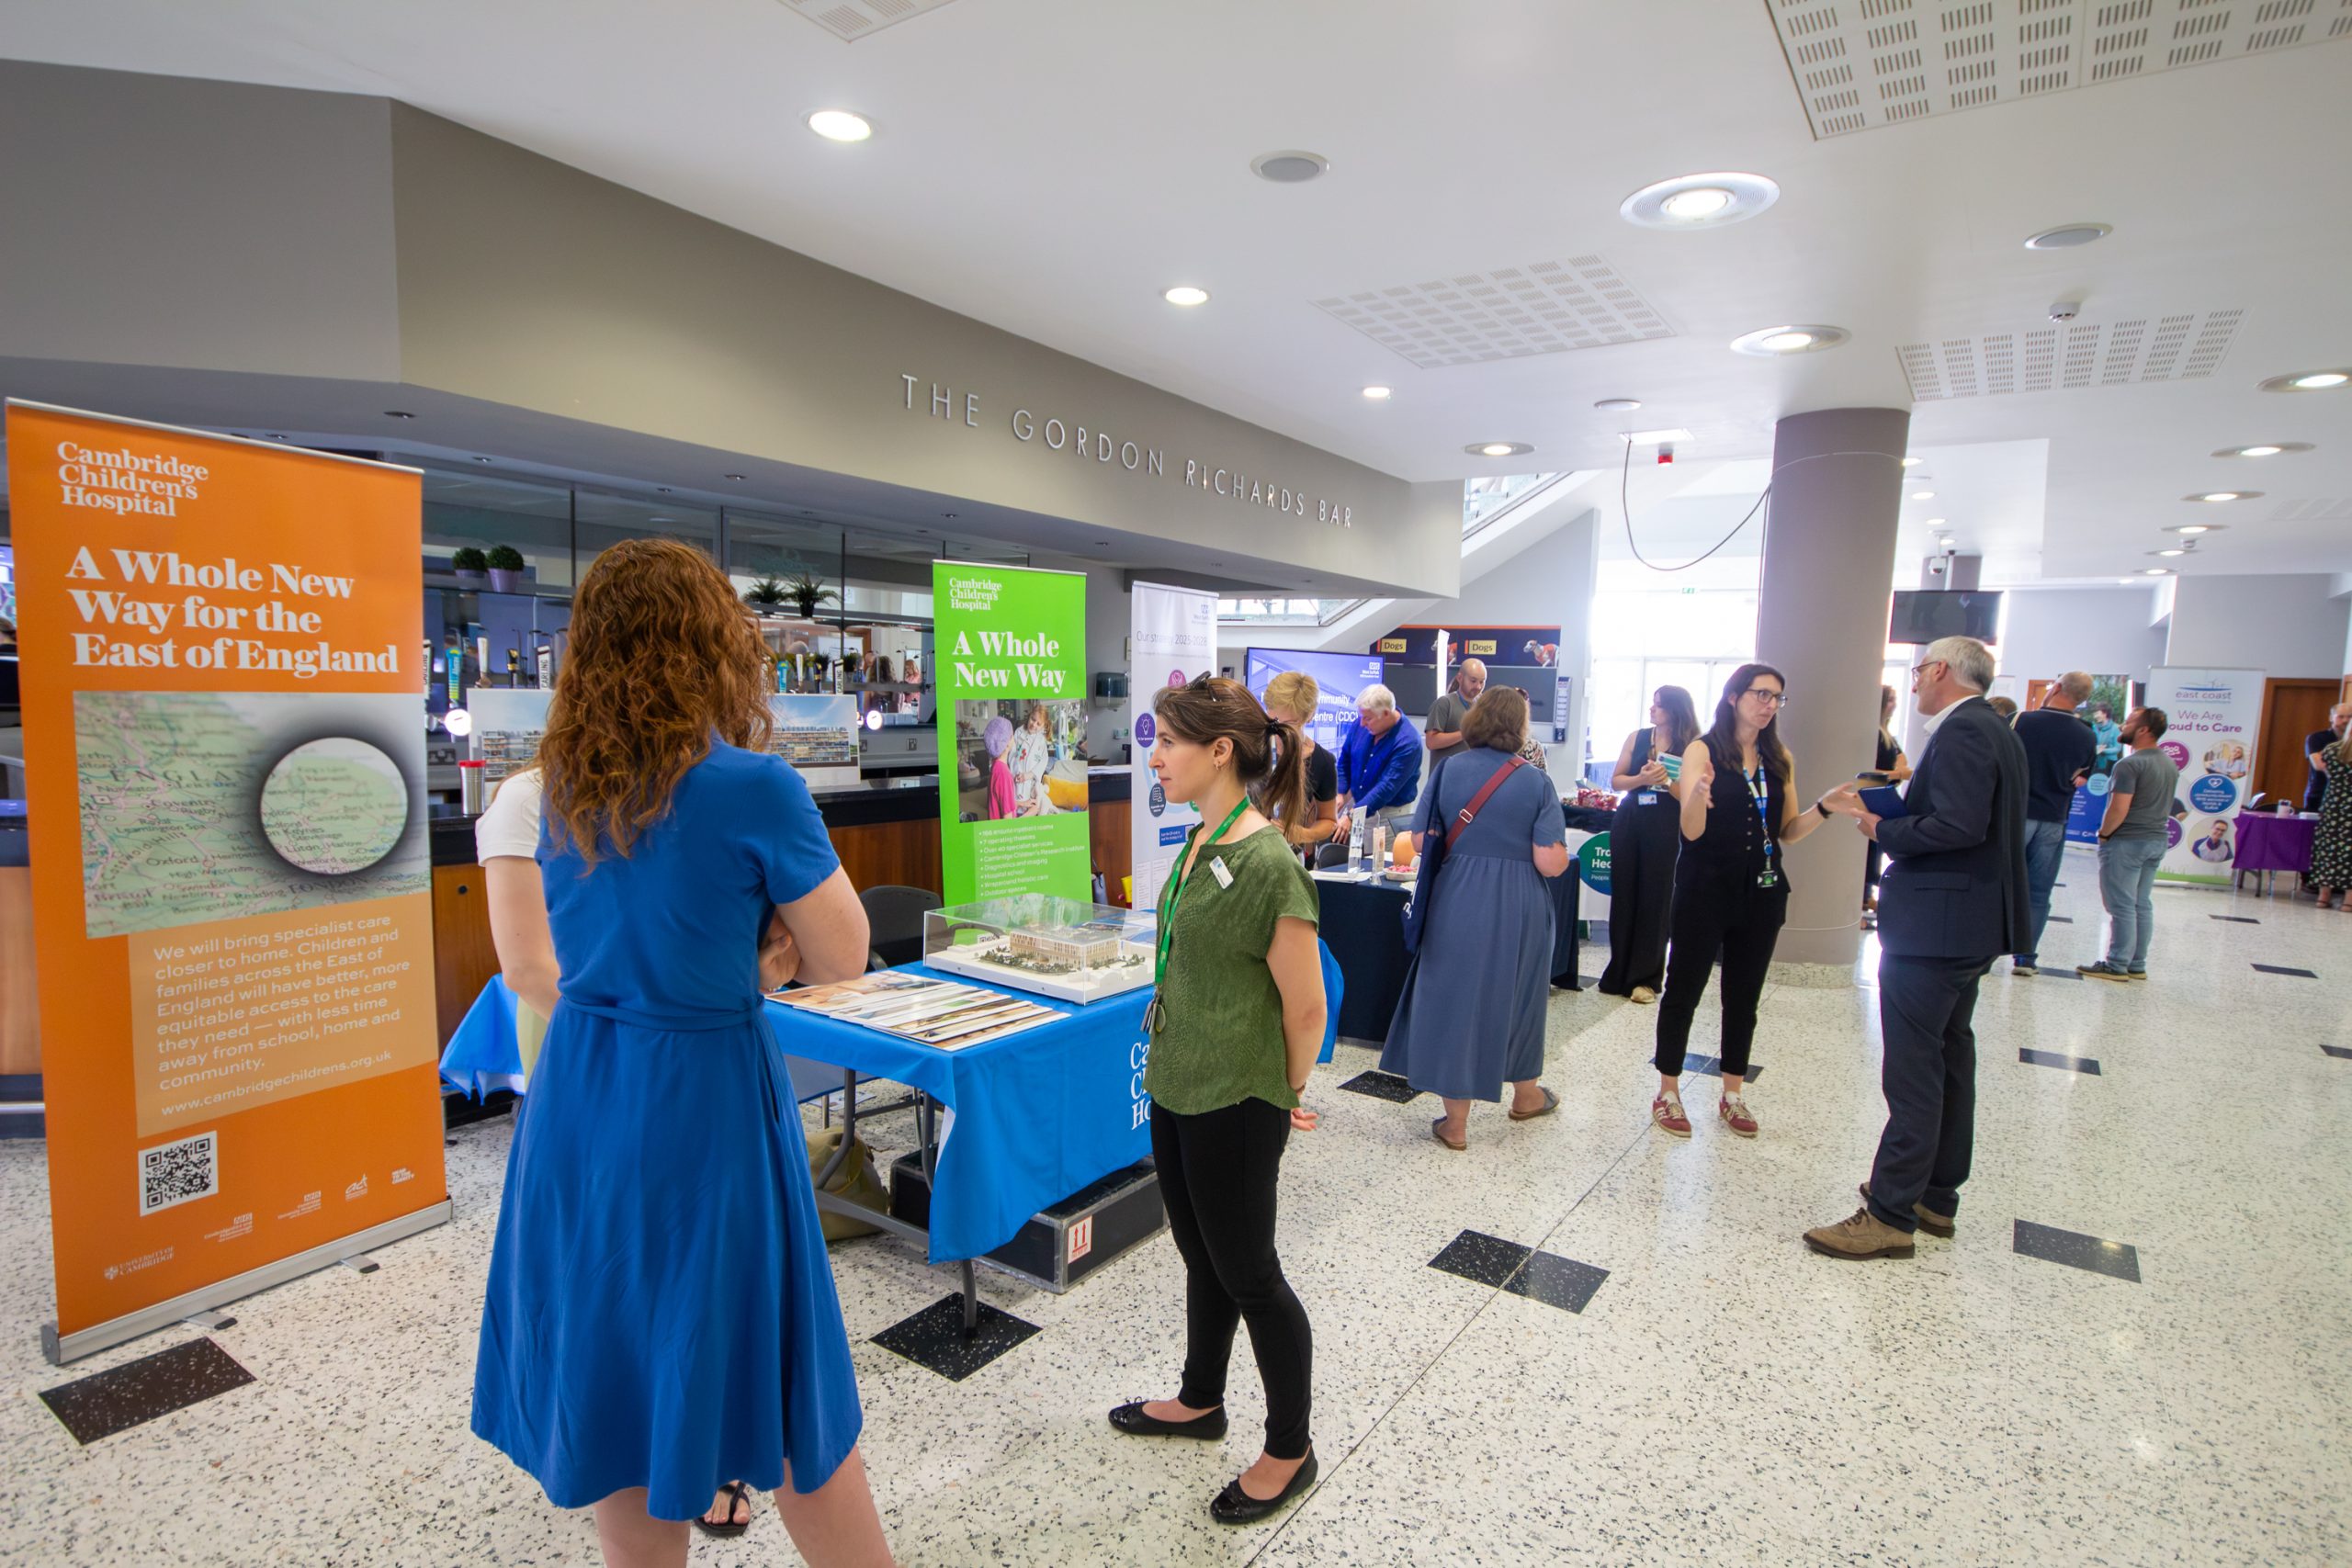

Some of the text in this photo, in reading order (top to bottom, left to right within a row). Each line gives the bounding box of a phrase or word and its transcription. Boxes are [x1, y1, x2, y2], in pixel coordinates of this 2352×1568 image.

[57, 441, 209, 482] Cambridge
[902, 374, 1352, 529] THE GORDON RICHARDS BAR
[58, 464, 198, 500] Children's
[62, 485, 176, 517] Hospital
[65, 546, 355, 599] A Whole New
[949, 577, 1002, 592] Cambridge
[950, 588, 999, 601] Children's
[951, 598, 991, 612] Hospital
[66, 589, 322, 635] Way for the
[71, 633, 400, 679] East of England
[952, 630, 1060, 658] A Whole
[1384, 642, 1404, 651] Dogs
[1472, 643, 1493, 652] Dogs
[540, 660, 548, 689] CARLING
[954, 662, 1067, 694] New Way
[2201, 692, 2233, 700] coast
[2168, 722, 2243, 733] oud to Care
[2177, 710, 2223, 721] We Are
[146, 855, 199, 867] Oxford
[154, 916, 390, 961] We will bring specialist care
[155, 929, 399, 980] closer to home. Children and
[156, 947, 383, 998] families across the East of
[157, 961, 410, 1017] England will have better, more
[156, 979, 397, 1035] equitable access to the care
[158, 1035, 199, 1054] they
[205, 1022, 250, 1043] need
[277, 1010, 312, 1028] with
[317, 1005, 350, 1020] less
[353, 998, 388, 1012] time
[158, 1009, 401, 1073] away from school, home and
[160, 1057, 265, 1090] community.
[162, 1050, 392, 1115] www.cambridgechildrens.org.uk
